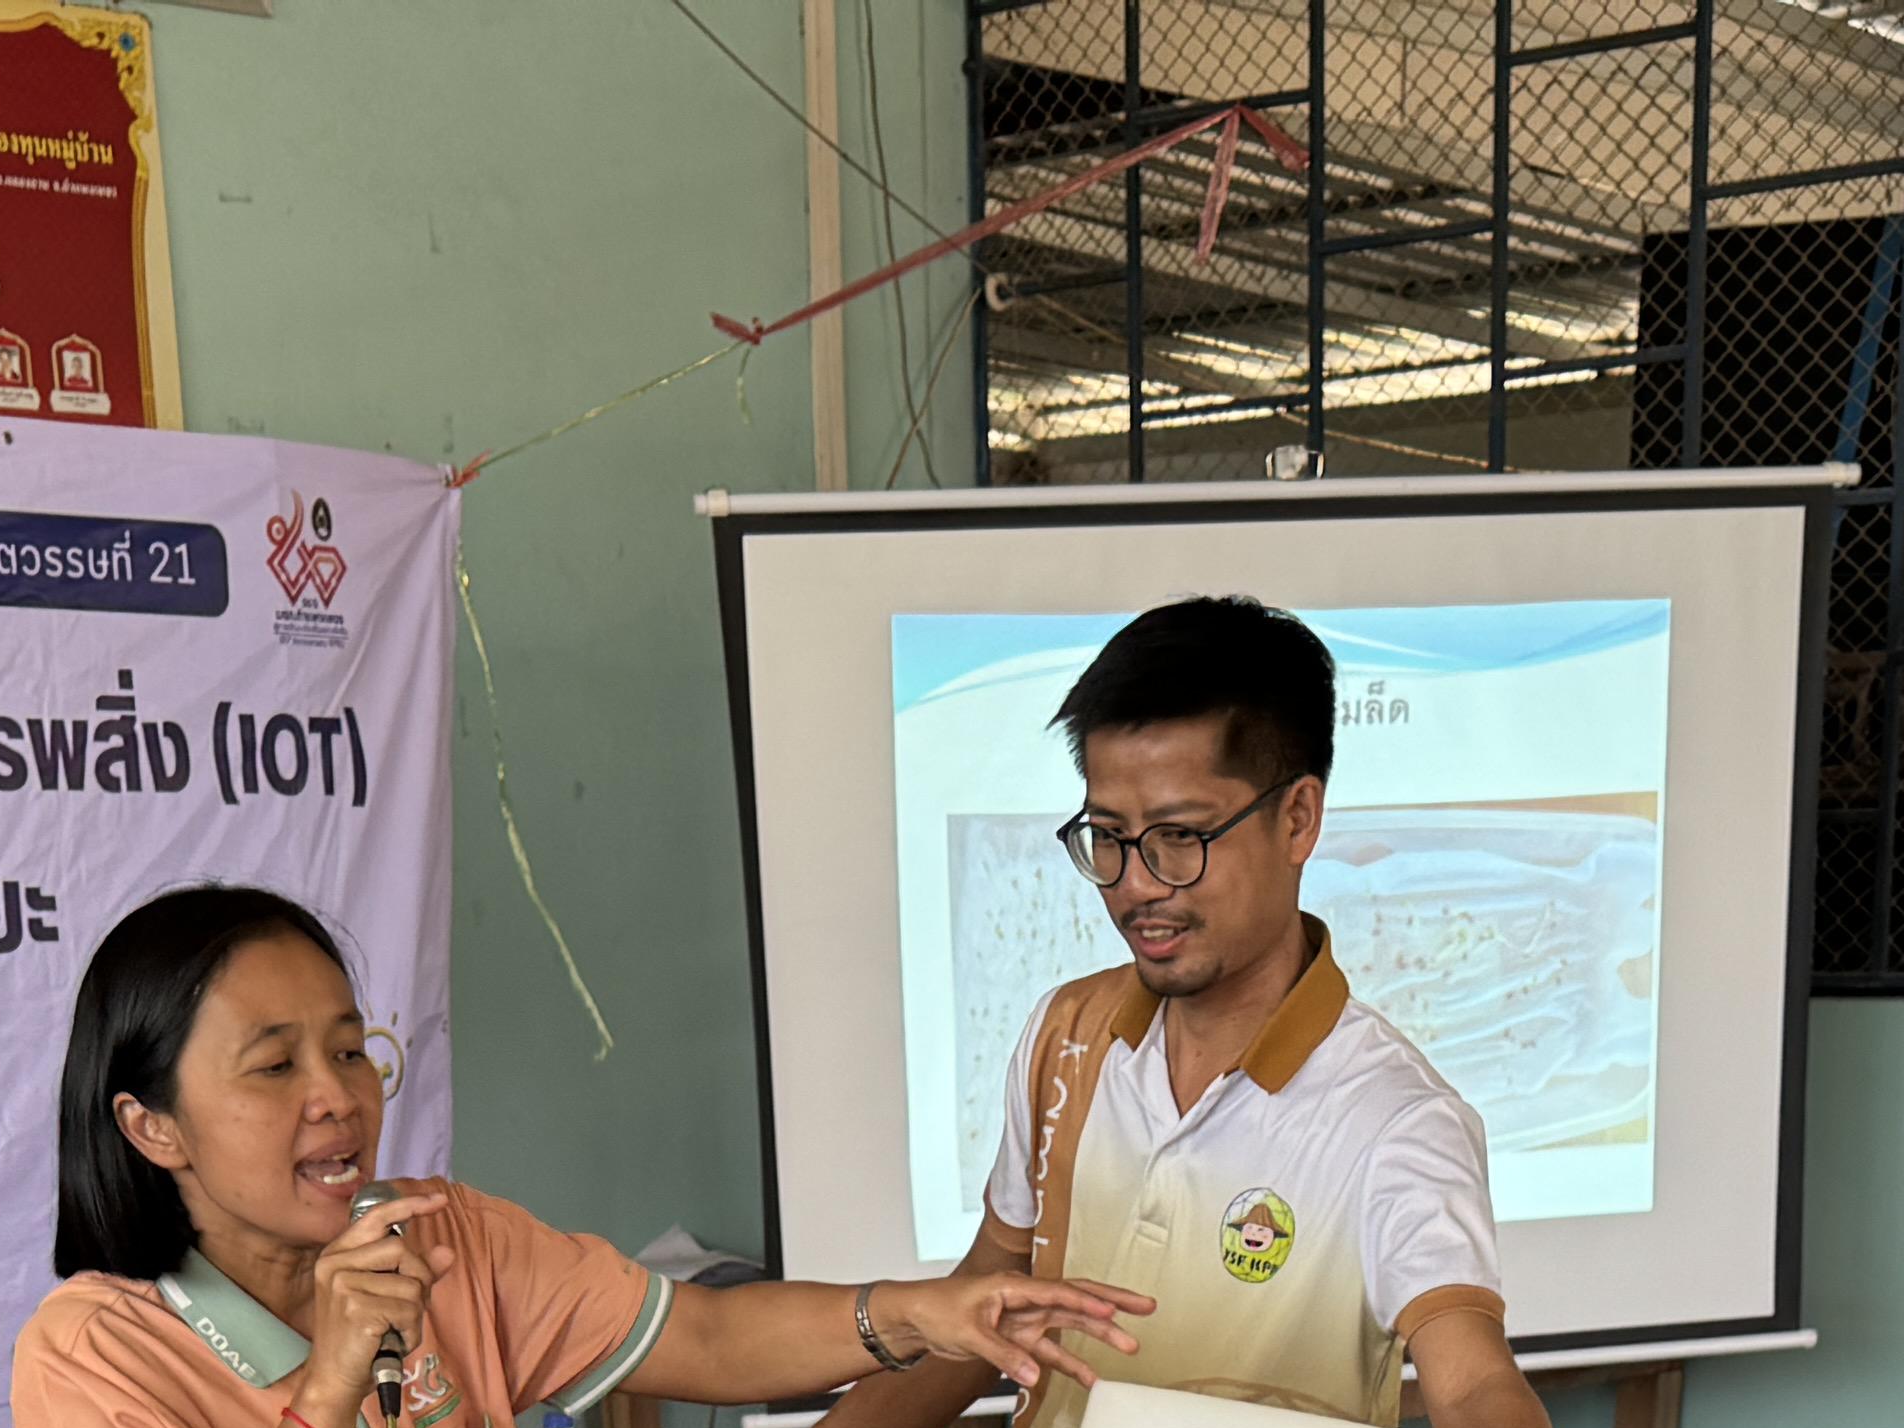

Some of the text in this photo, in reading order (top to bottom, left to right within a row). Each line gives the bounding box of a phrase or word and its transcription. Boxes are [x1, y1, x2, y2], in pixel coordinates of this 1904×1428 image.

[147, 540, 197, 587] 21
[1339, 680, 1410, 727] มล็ด
[212, 701, 370, 808] (IOT)
